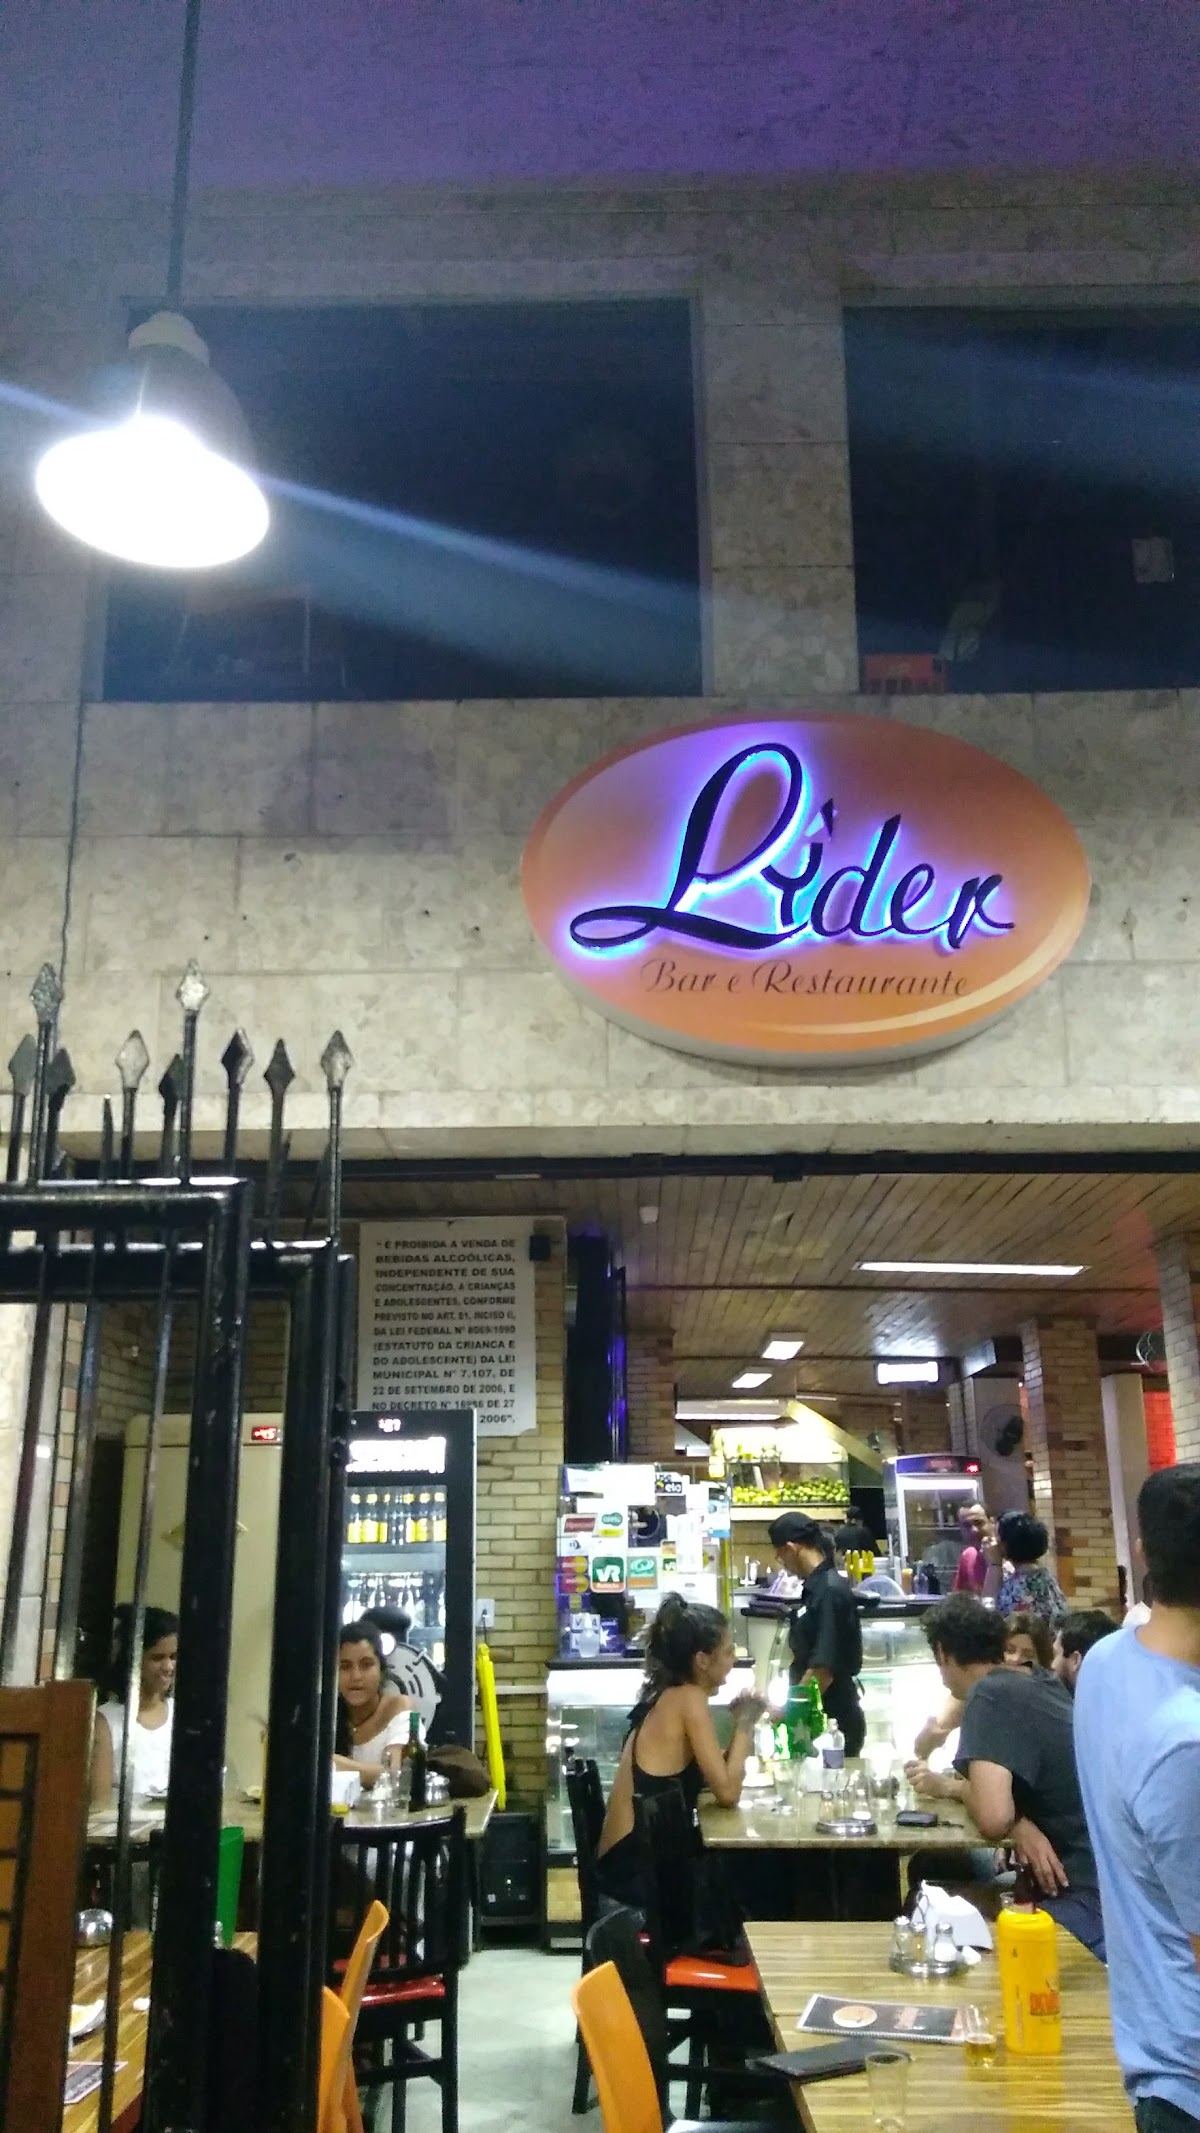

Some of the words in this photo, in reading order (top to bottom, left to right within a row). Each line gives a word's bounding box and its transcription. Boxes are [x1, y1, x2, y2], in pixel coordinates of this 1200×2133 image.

[641, 958, 717, 994] Bar
[727, 973, 741, 995] e
[752, 958, 972, 997] Restaurante
[395, 1240, 446, 1249] PROIBIDA
[450, 1240, 457, 1248] A
[501, 1239, 515, 1247] DE
[376, 1255, 429, 1264] BEBIDAS
[376, 1268, 468, 1278] INDEPENDENTE
[472, 1268, 486, 1276] DE
[491, 1268, 515, 1276] SUA
[468, 1282, 515, 1292] CRIANÇAS
[375, 1298, 381, 1306] E
[464, 1296, 515, 1304] CONFORME
[374, 1313, 418, 1321] PREVISTO
[374, 1328, 386, 1336] DA
[408, 1327, 451, 1335] FEDERAL
[508, 1340, 515, 1348] E
[373, 1357, 388, 1366] DO
[392, 1356, 476, 1365] ADOLESCENTE)
[480, 1356, 494, 1364] DA
[499, 1355, 515, 1363] LEI
[373, 1370, 439, 1379] MUNICIPAL
[500, 1369, 515, 1377] DE
[373, 1386, 384, 1395] 22
[388, 1386, 400, 1395] DE
[404, 1385, 460, 1394] SETEMBRO
[463, 1385, 476, 1393] DE
[510, 1384, 515, 1392] E
[372, 1402, 386, 1410] NO
[487, 1400, 500, 1408] DE
[504, 1400, 515, 1408] 27
